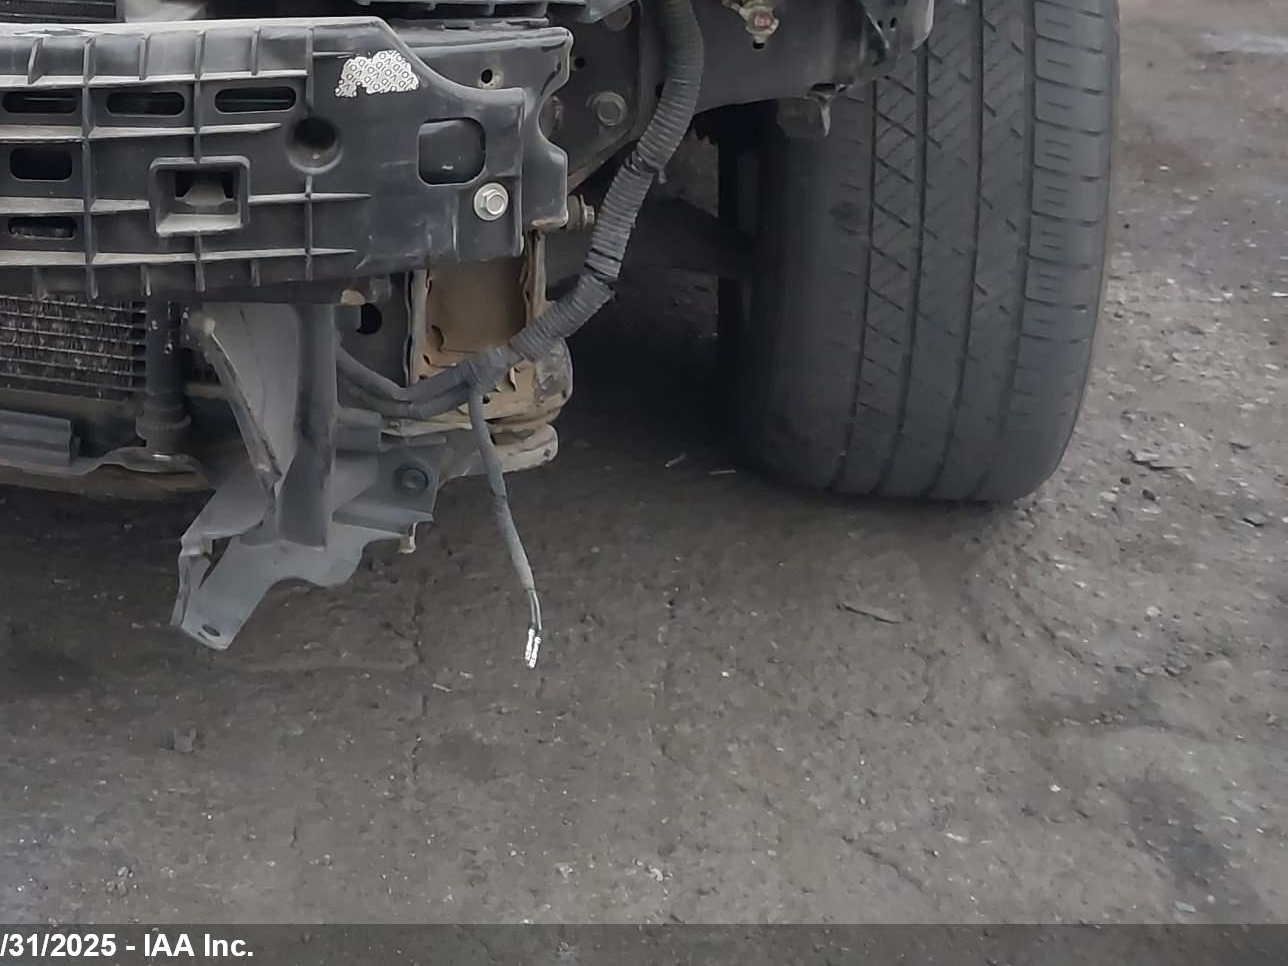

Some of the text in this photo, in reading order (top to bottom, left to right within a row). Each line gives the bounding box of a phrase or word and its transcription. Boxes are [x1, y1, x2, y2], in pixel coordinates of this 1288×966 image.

[346, 61, 380, 91] OID VOI
[358, 59, 379, 78] VOID
[376, 61, 397, 81] VOID
[394, 63, 414, 83] VOID
